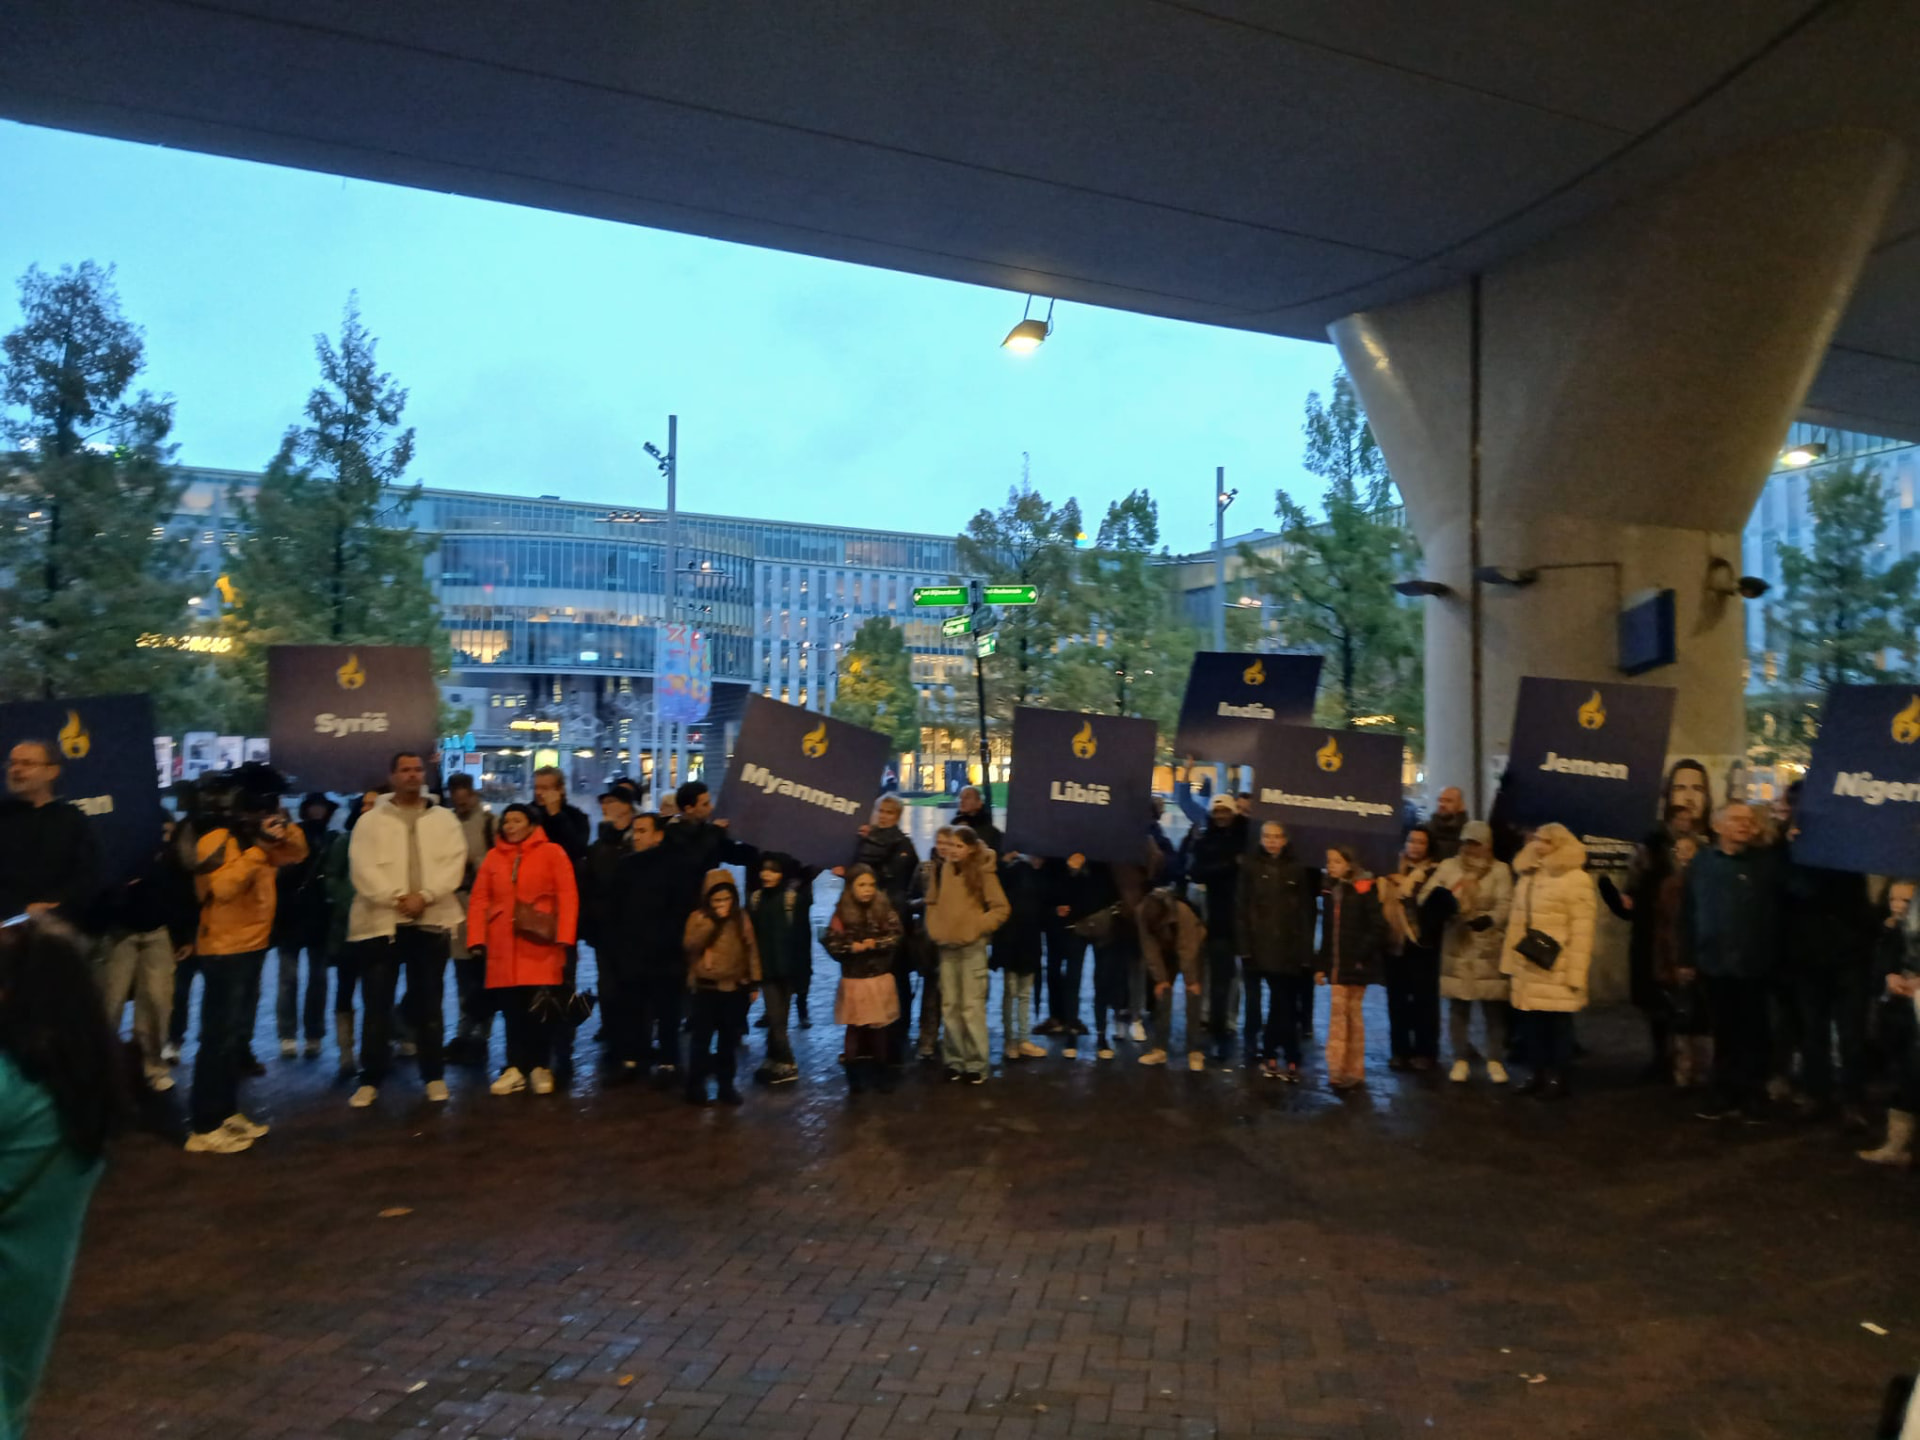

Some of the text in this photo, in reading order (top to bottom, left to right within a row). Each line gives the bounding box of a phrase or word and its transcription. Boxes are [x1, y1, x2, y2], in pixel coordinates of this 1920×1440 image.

[314, 711, 390, 738] Syrië
[1539, 751, 1629, 780] Jemen
[739, 762, 861, 815] Myanmar
[1049, 780, 1111, 806] Libië
[1260, 787, 1394, 817] Mozambique
